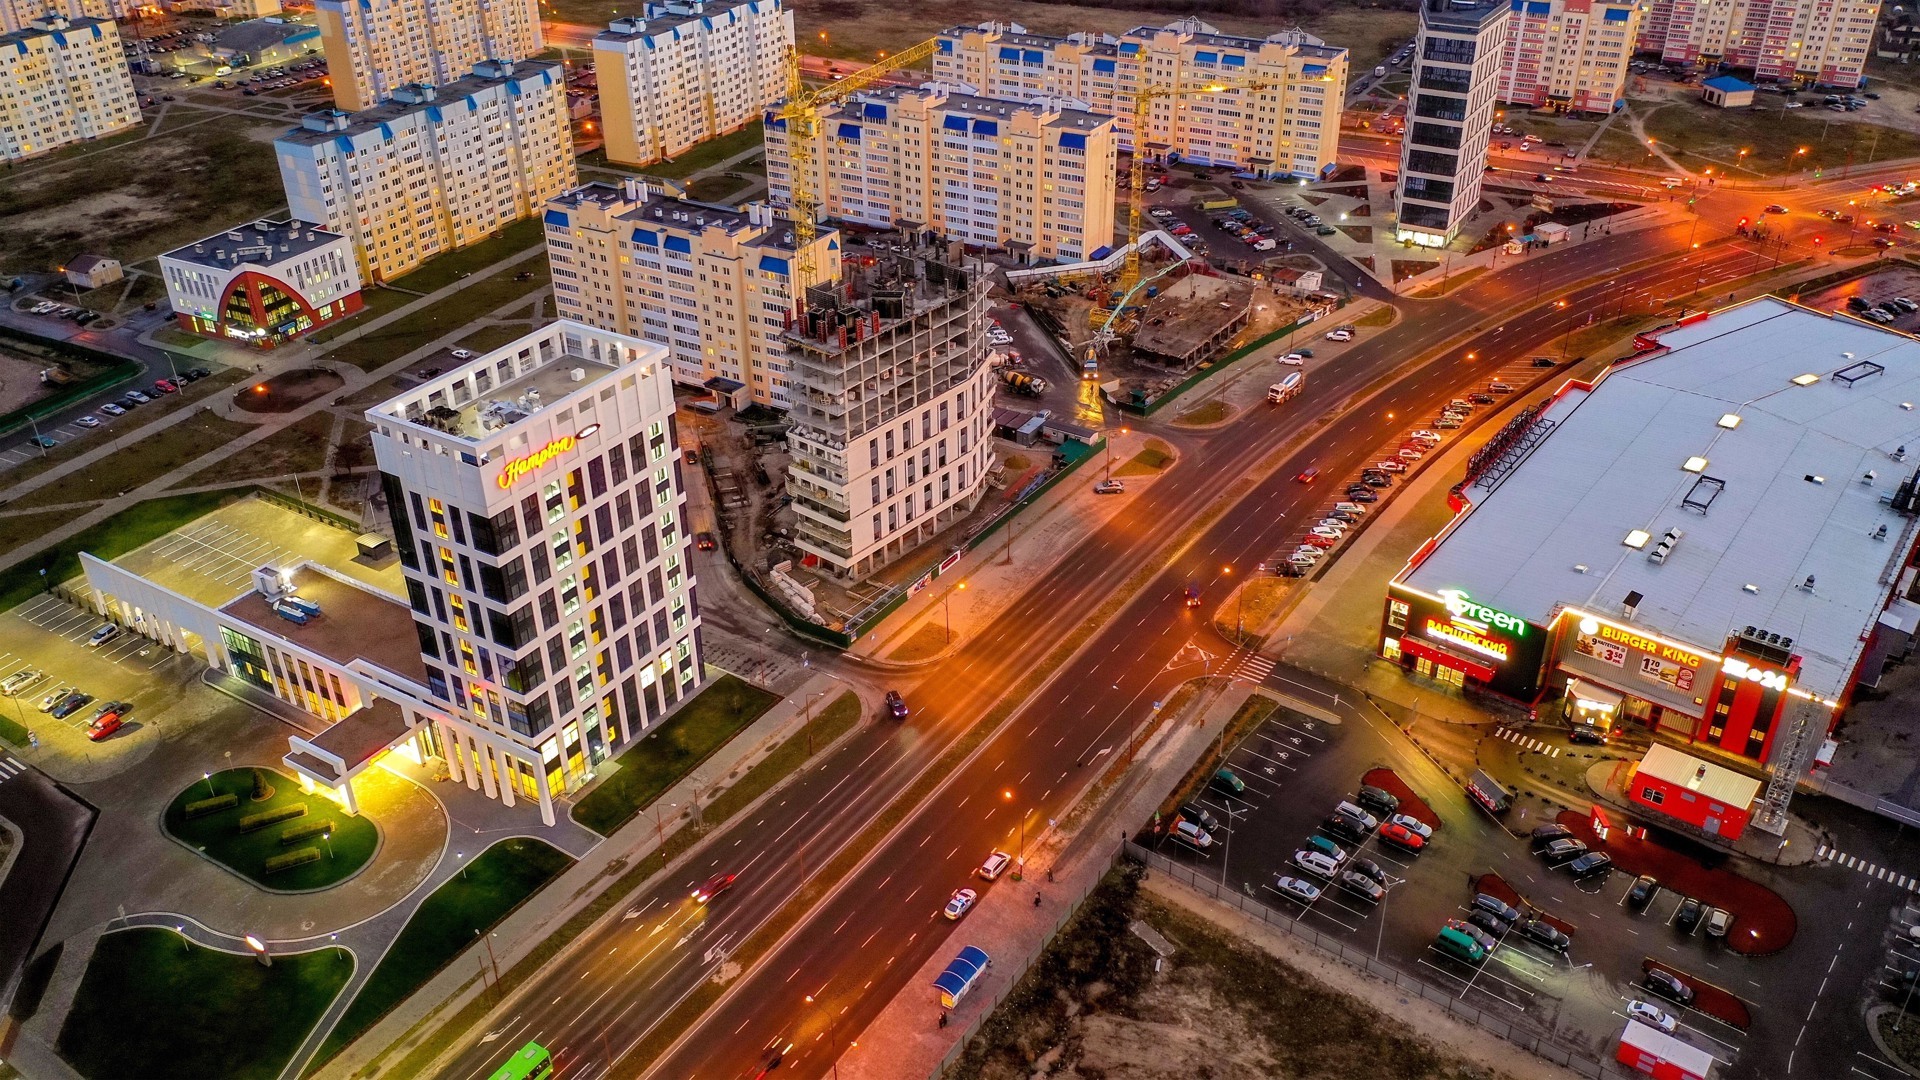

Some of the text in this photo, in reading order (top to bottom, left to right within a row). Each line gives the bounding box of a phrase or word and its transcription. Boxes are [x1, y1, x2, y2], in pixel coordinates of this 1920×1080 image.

[498, 436, 575, 489] Hampton
[1444, 590, 1525, 636] Green
[1427, 619, 1507, 654] ВАРШАВСКИЙ
[1602, 626, 1700, 667] BURGER KING
